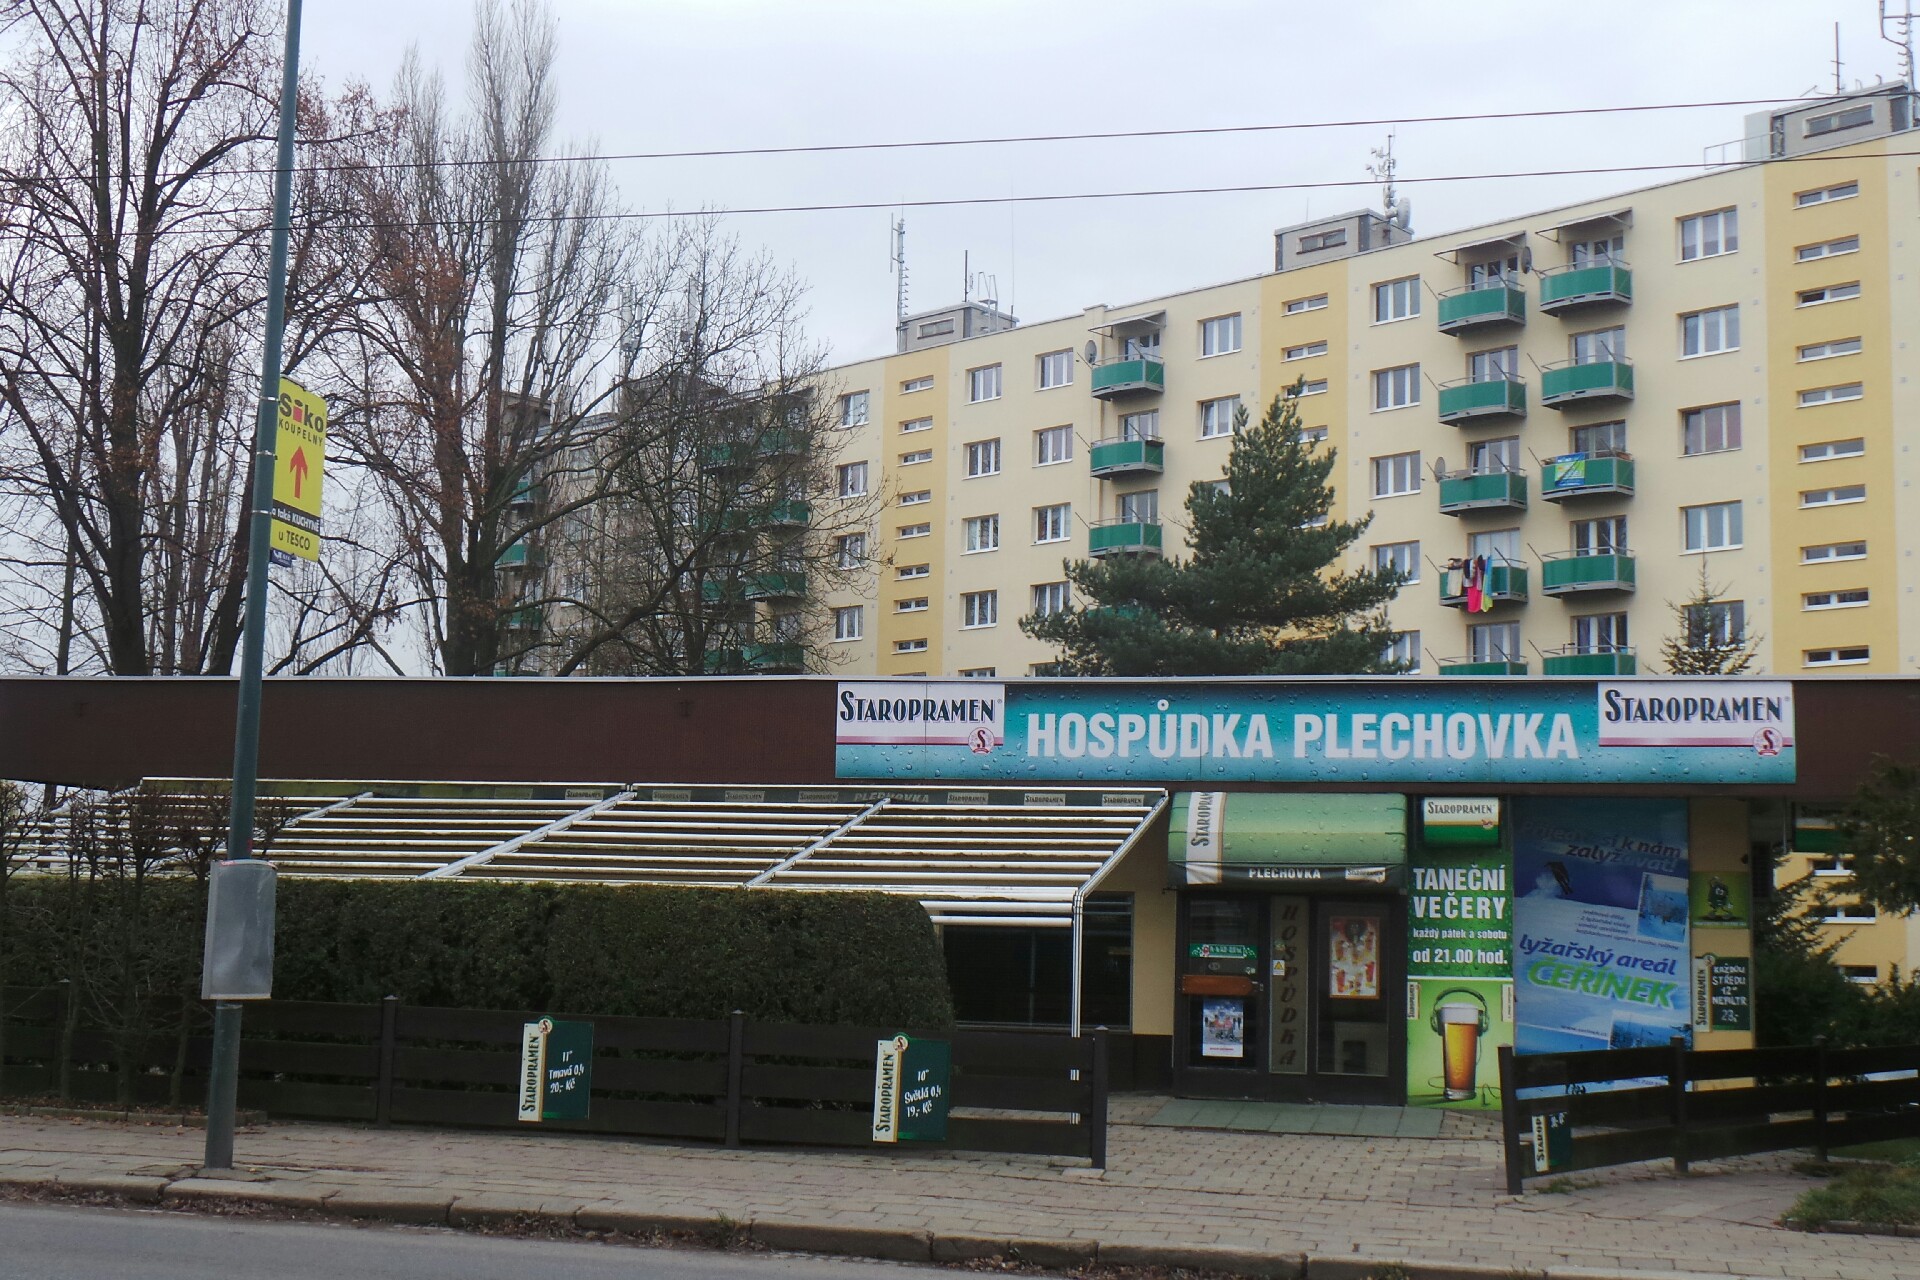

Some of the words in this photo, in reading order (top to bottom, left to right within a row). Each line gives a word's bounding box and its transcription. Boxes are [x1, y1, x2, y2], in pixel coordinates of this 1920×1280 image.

[278, 417, 323, 447] KOUPELNY
[277, 508, 292, 522] také
[292, 512, 320, 532] KUCHYNĚ
[278, 531, 285, 541] u
[286, 530, 311, 551] TESCO
[839, 690, 995, 724] STAROPRAMEN
[1604, 688, 1784, 724] STAROPRAMEN
[1027, 699, 1274, 758] HOSPŮDKA
[1294, 711, 1579, 760] PLECHOVKA
[1025, 795, 1063, 805] STAROPRAMEN
[1428, 801, 1492, 814] STAROPRAMEN
[1622, 836, 1635, 850] k
[1637, 842, 1681, 859] nám
[1249, 868, 1321, 879] PLECHOVKA
[1413, 865, 1506, 891] TANEČNÍ
[1413, 892, 1506, 920] VEČERY
[1413, 928, 1439, 939] každý
[1441, 928, 1466, 938] pátek
[1477, 929, 1507, 939] sobotu
[1413, 948, 1430, 963] od
[1434, 949, 1473, 963] 21.00
[1477, 950, 1508, 964] hod.
[1519, 933, 1615, 967] lyžařský
[1616, 954, 1677, 976] areál
[1526, 953, 1681, 1010] ČEŘÍNEK
[1712, 975, 1746, 985] STŘEDU
[1696, 969, 1707, 1025] STAROPRAMEN
[521, 1036, 539, 1112] STAROPRAMEN
[549, 1067, 572, 1080] Tmavá
[565, 1077, 576, 1091] Kč
[875, 1054, 894, 1132] STAROPRAMEN
[904, 1086, 929, 1104] Světlá
[922, 1099, 933, 1115] Kč
